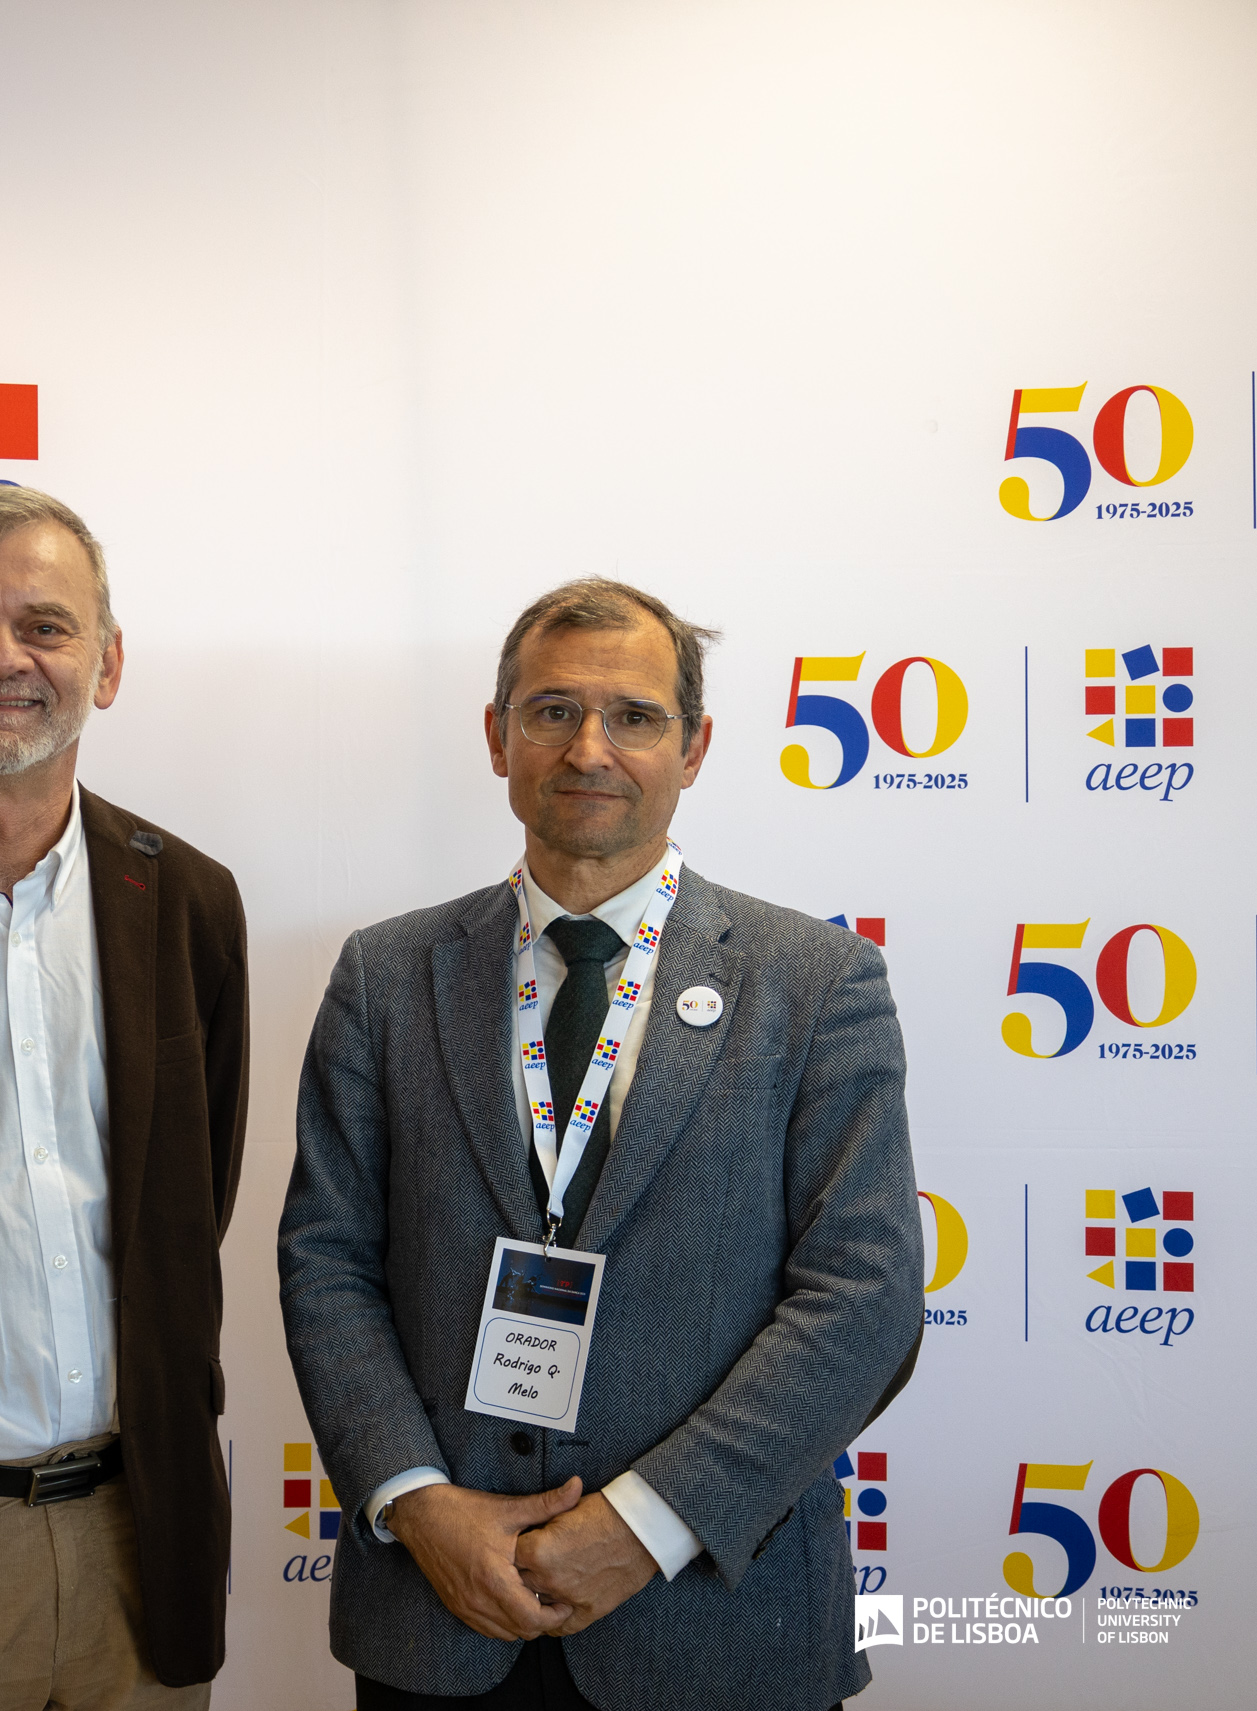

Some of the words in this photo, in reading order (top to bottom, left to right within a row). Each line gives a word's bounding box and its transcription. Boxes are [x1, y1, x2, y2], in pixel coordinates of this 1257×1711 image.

[999, 380, 1194, 521] 50
[1095, 501, 1194, 519] 1975-2025
[780, 650, 968, 789] 50
[872, 773, 968, 790] 1975-2025
[1085, 762, 1194, 802] aeep
[655, 887, 674, 902] aeep
[633, 941, 654, 956] aeep
[1002, 917, 1197, 1059] 50
[518, 1000, 539, 1012] aeep
[612, 998, 634, 1011] aeep
[682, 1000, 698, 1011] 50
[1098, 1043, 1197, 1060] 1975-2025
[524, 1061, 546, 1071] aeep
[591, 1057, 613, 1071] aeep
[535, 1121, 555, 1131] aeep
[569, 1117, 591, 1133] aeep
[1085, 1305, 1195, 1347] aeep
[505, 1332, 557, 1352] ORADOR
[493, 1352, 541, 1375] Rodrigo
[507, 1382, 539, 1399] Melo
[1002, 1459, 1200, 1600] 50
[282, 1555, 332, 1582] ae
